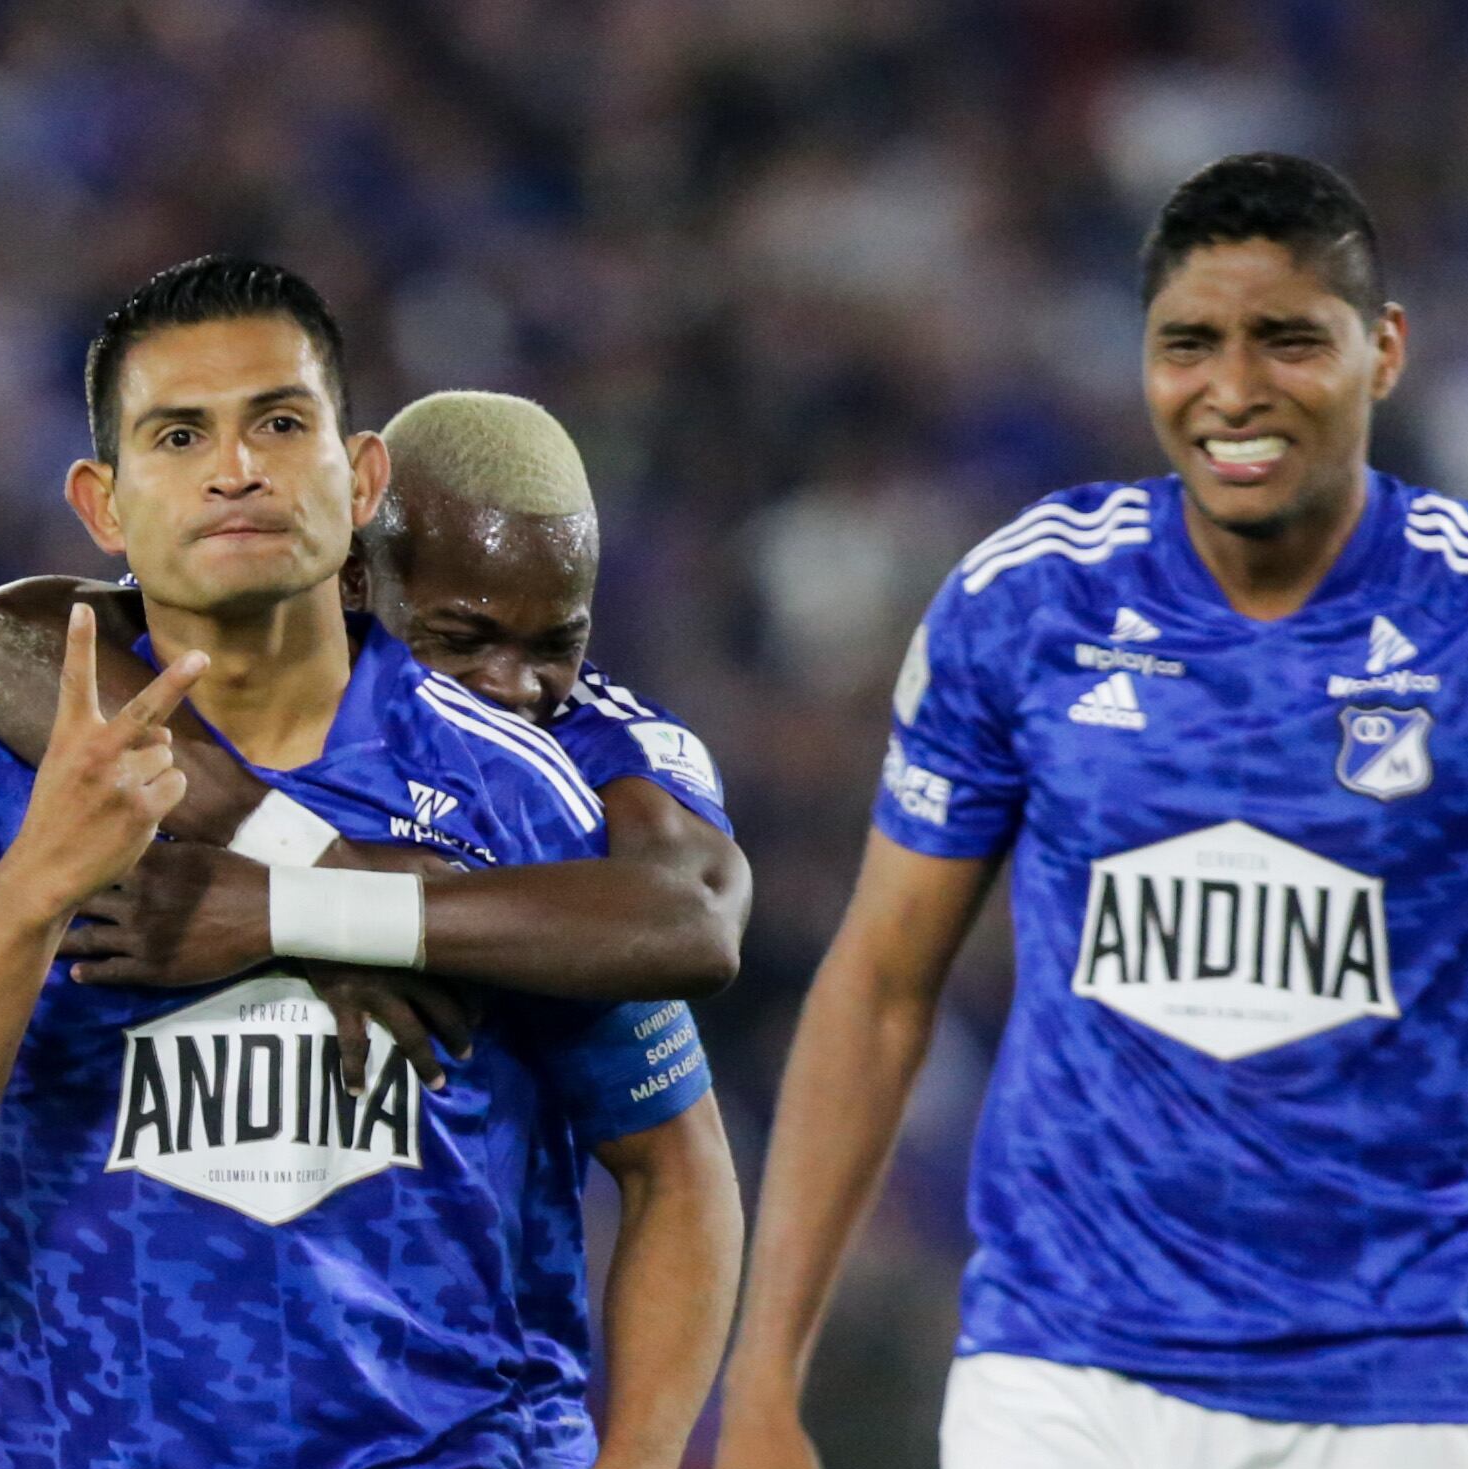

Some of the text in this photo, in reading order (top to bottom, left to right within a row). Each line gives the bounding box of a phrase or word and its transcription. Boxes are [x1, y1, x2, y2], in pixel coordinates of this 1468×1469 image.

[1086, 871, 1381, 1004] ANDINA
[239, 1003, 309, 1023] CERVEZA
[646, 1024, 693, 1066] SOMOS
[117, 1034, 410, 1162] ANDINA
[208, 1168, 256, 1183] COLOMBIA
[259, 1169, 270, 1183] EN
[273, 1170, 293, 1184] UNA
